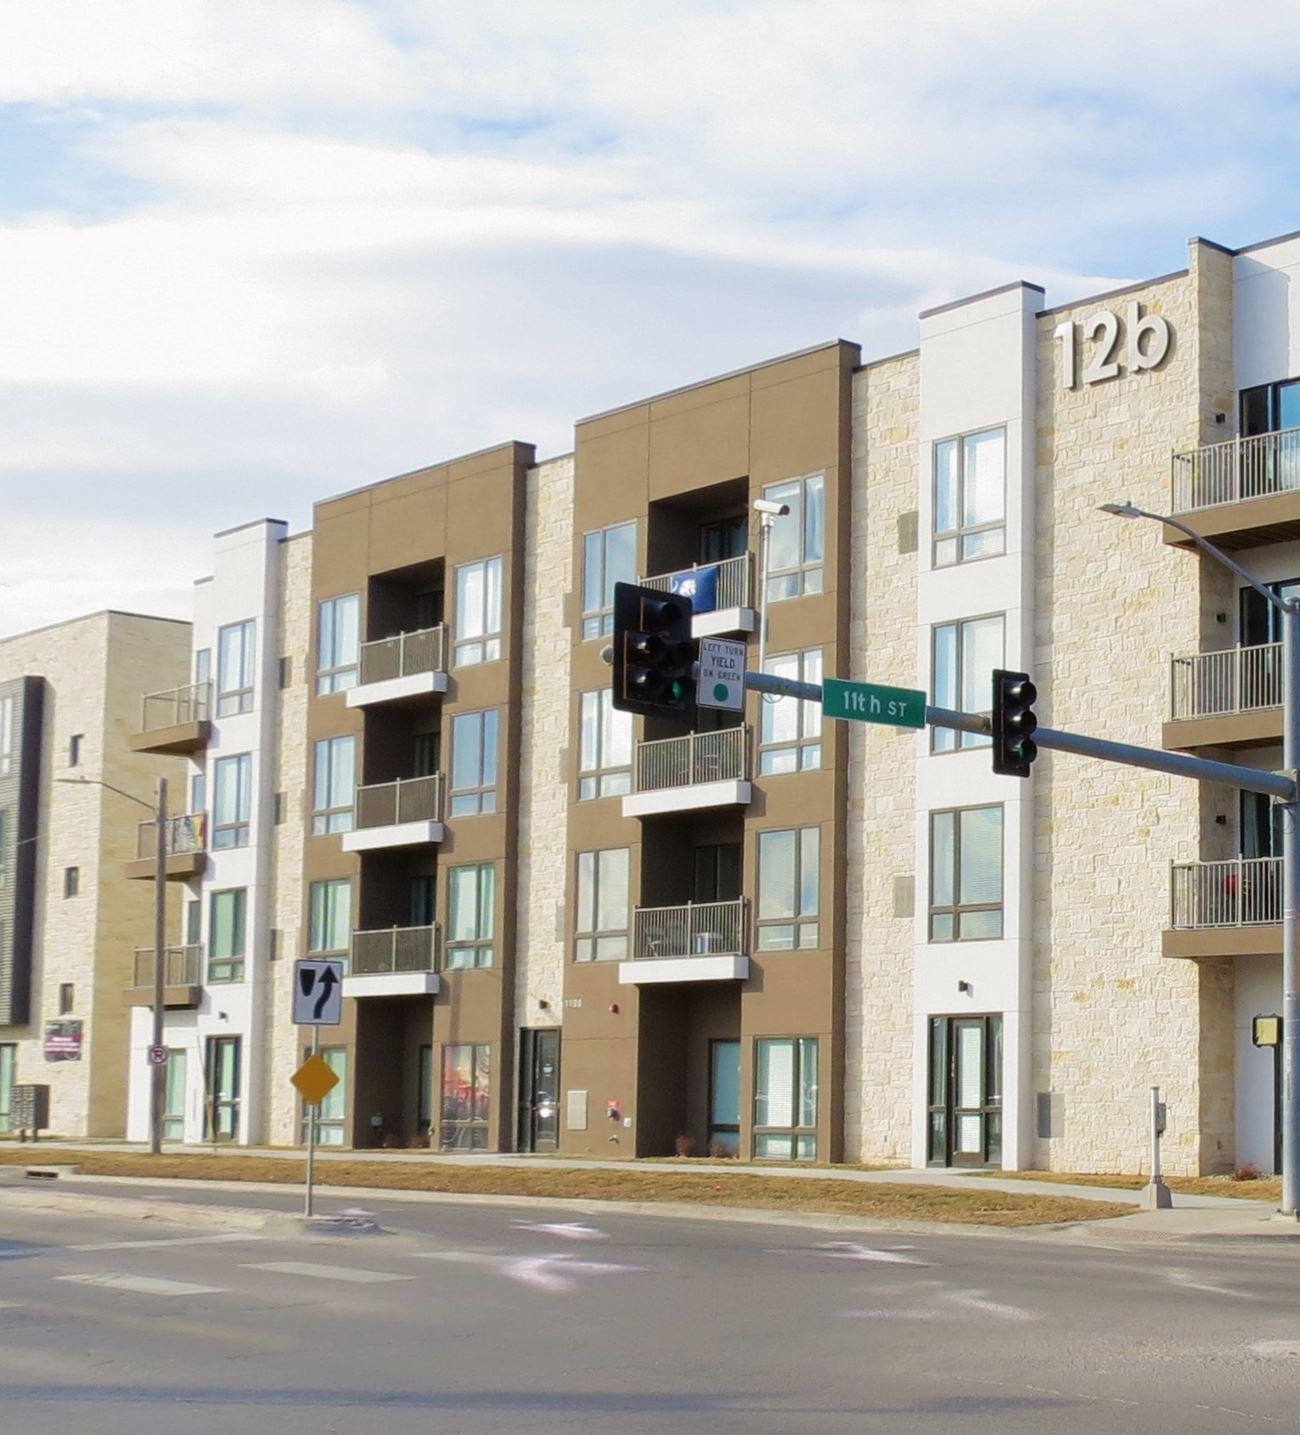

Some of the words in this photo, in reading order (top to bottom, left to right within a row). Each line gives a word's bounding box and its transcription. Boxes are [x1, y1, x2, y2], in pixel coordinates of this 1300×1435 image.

[1053, 301, 1173, 391] 12b
[711, 656, 735, 669] YIELD
[843, 690, 881, 714] 11th
[887, 701, 907, 717] ST
